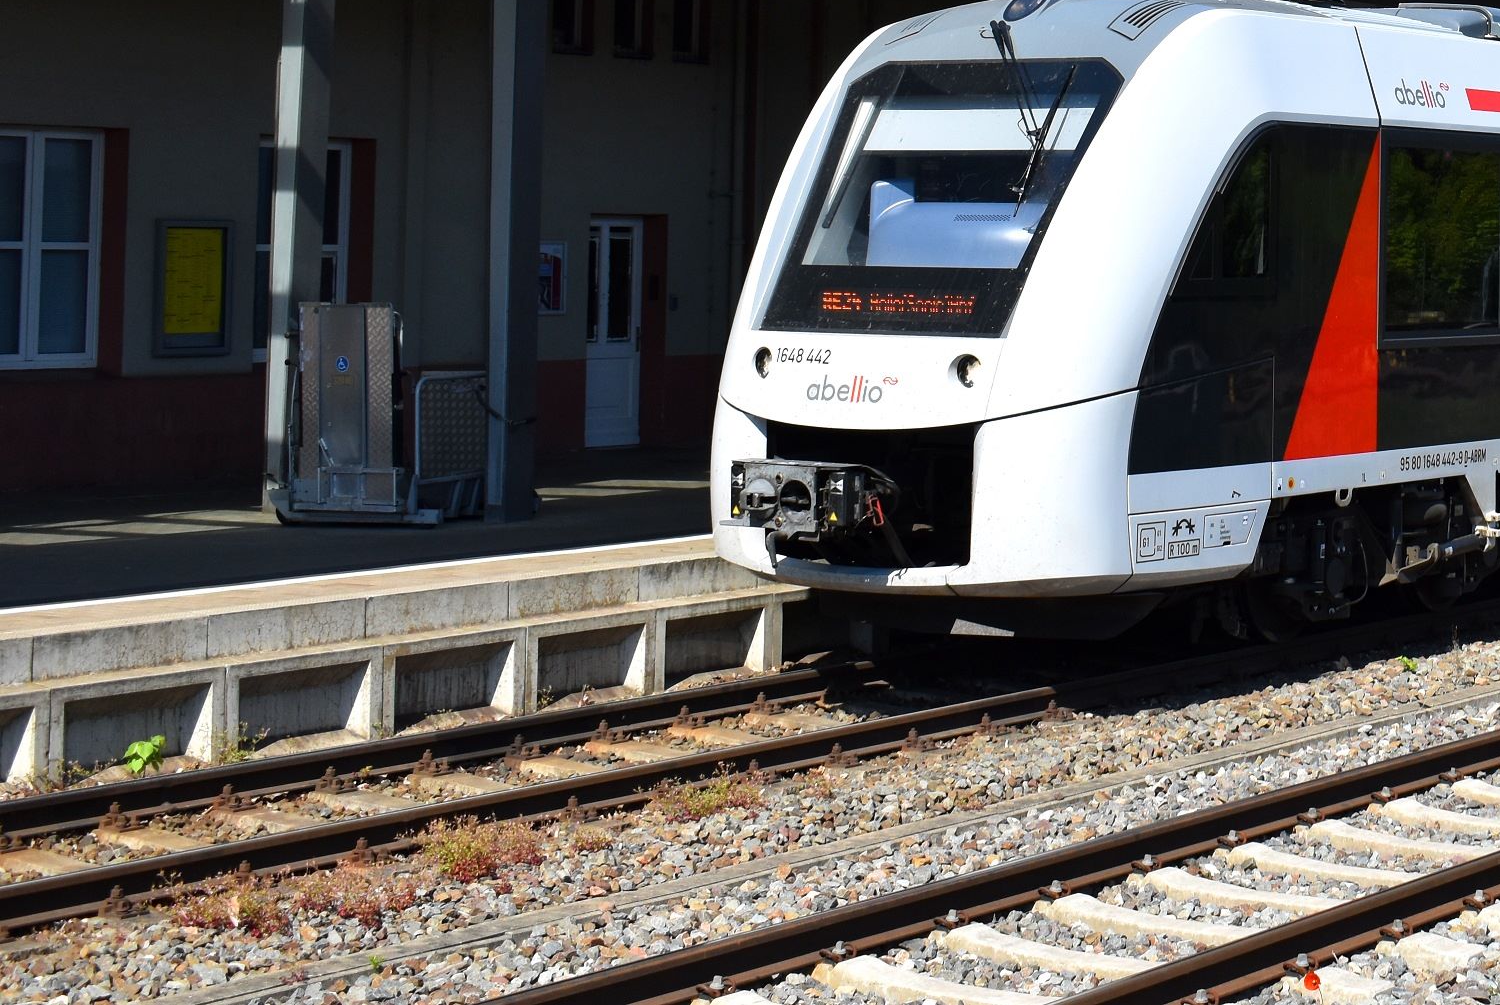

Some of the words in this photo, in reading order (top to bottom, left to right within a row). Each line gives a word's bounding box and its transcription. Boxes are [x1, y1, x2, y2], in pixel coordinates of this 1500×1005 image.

[1394, 78, 1446, 109] abellio
[776, 347, 804, 363] 1648
[806, 348, 832, 365] 442
[806, 374, 883, 404] abellio
[1400, 457, 1410, 471] 95
[1411, 455, 1422, 470] 80
[1423, 453, 1441, 469] 1648
[1441, 450, 1463, 466] 442-9
[1169, 545, 1175, 556] R
[1176, 542, 1190, 556] 100
[1191, 544, 1198, 553] m
